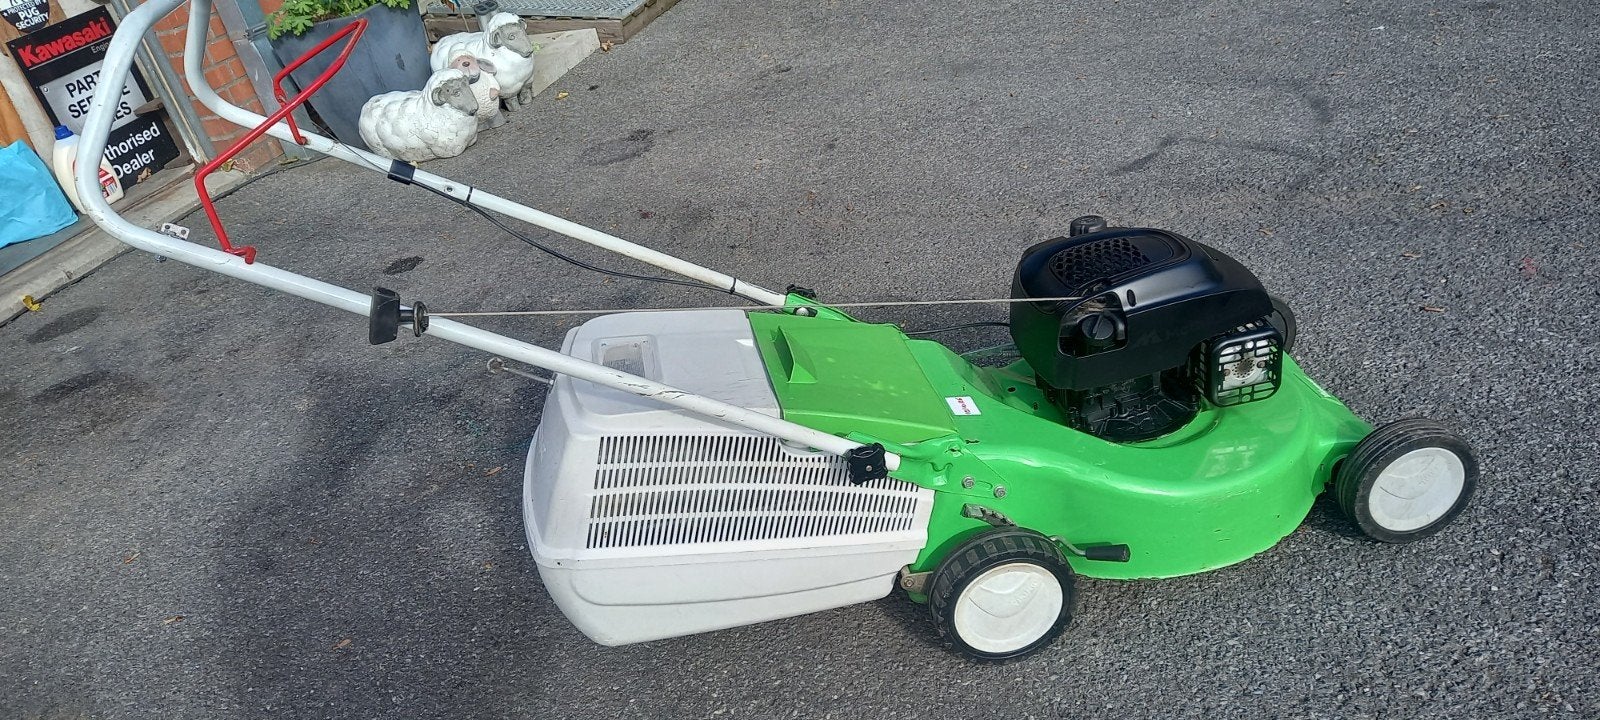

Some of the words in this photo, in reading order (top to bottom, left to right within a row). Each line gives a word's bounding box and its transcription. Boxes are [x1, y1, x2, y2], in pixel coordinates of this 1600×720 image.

[15, 12, 49, 30] SECURITY
[17, 6, 40, 21] PUG
[17, 16, 112, 68] Kawasaki
[90, 41, 109, 55] Engin
[65, 69, 101, 98] PART
[104, 121, 161, 161] thorised
[112, 149, 155, 180] Dealer
